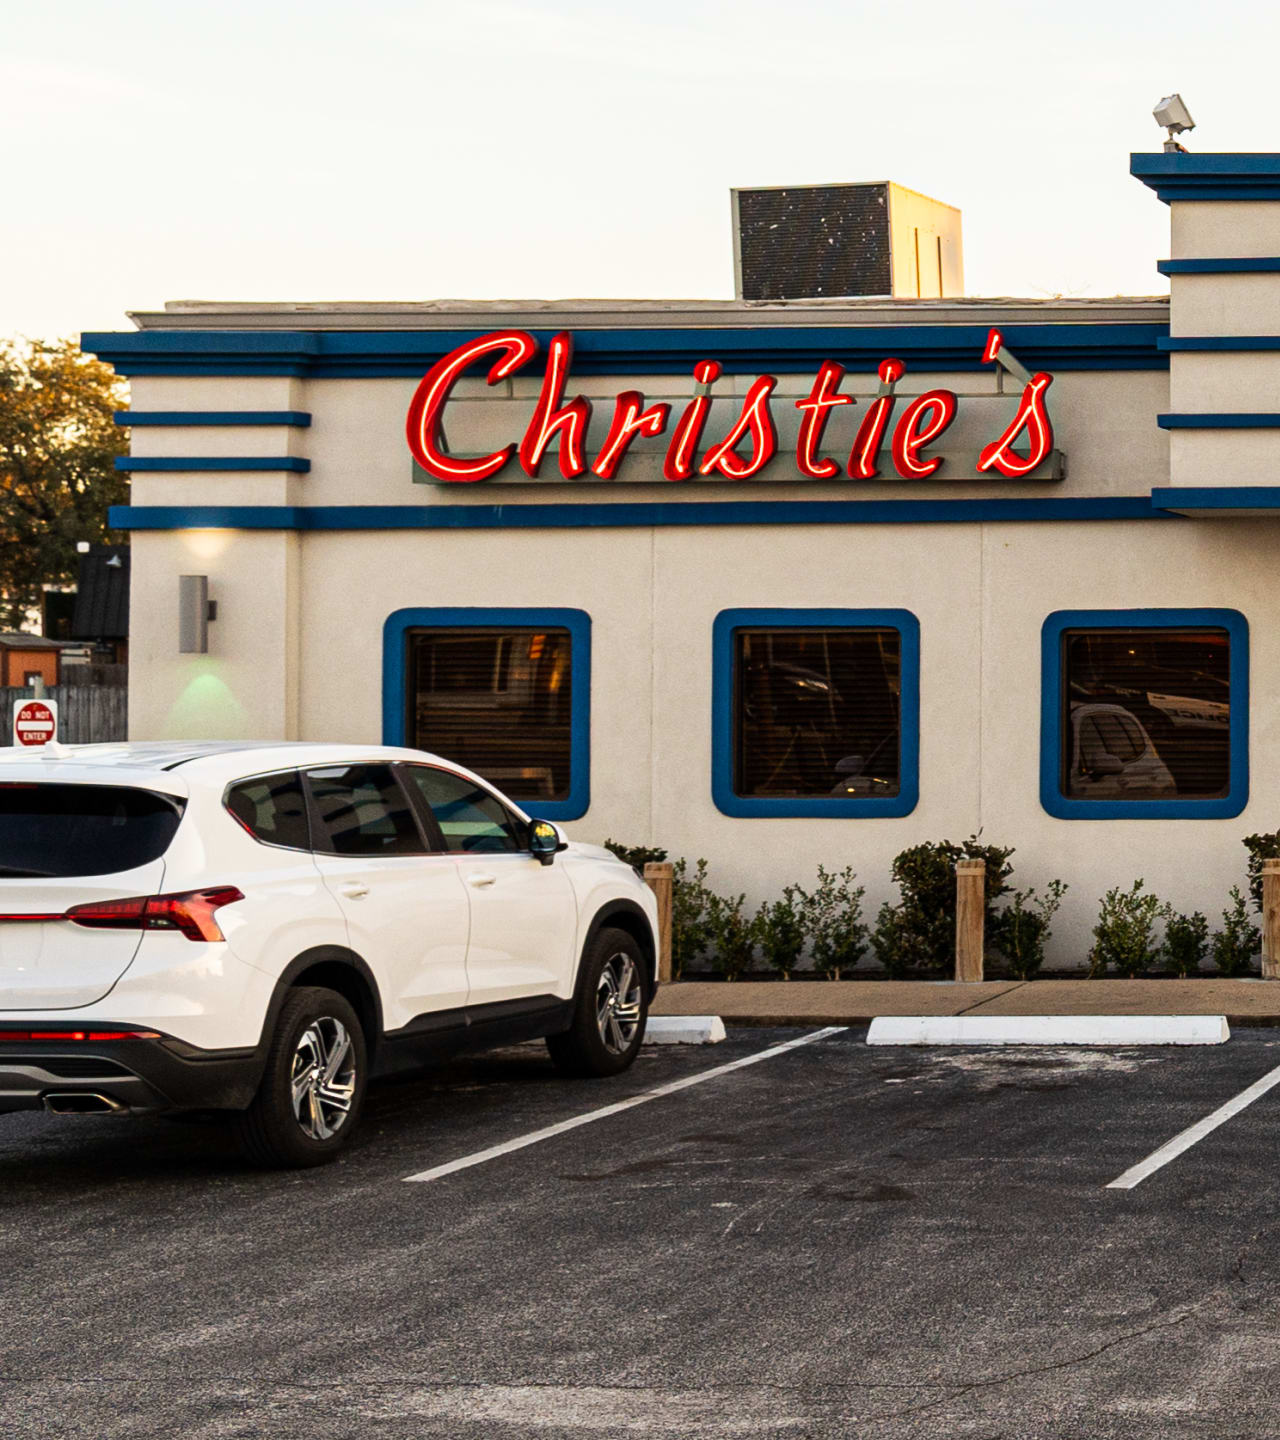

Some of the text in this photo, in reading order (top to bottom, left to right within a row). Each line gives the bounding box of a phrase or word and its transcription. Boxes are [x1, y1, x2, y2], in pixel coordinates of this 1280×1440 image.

[406, 328, 1053, 480] Christie's
[21, 710, 50, 720] DO NOT
[23, 731, 47, 741] ENTER
